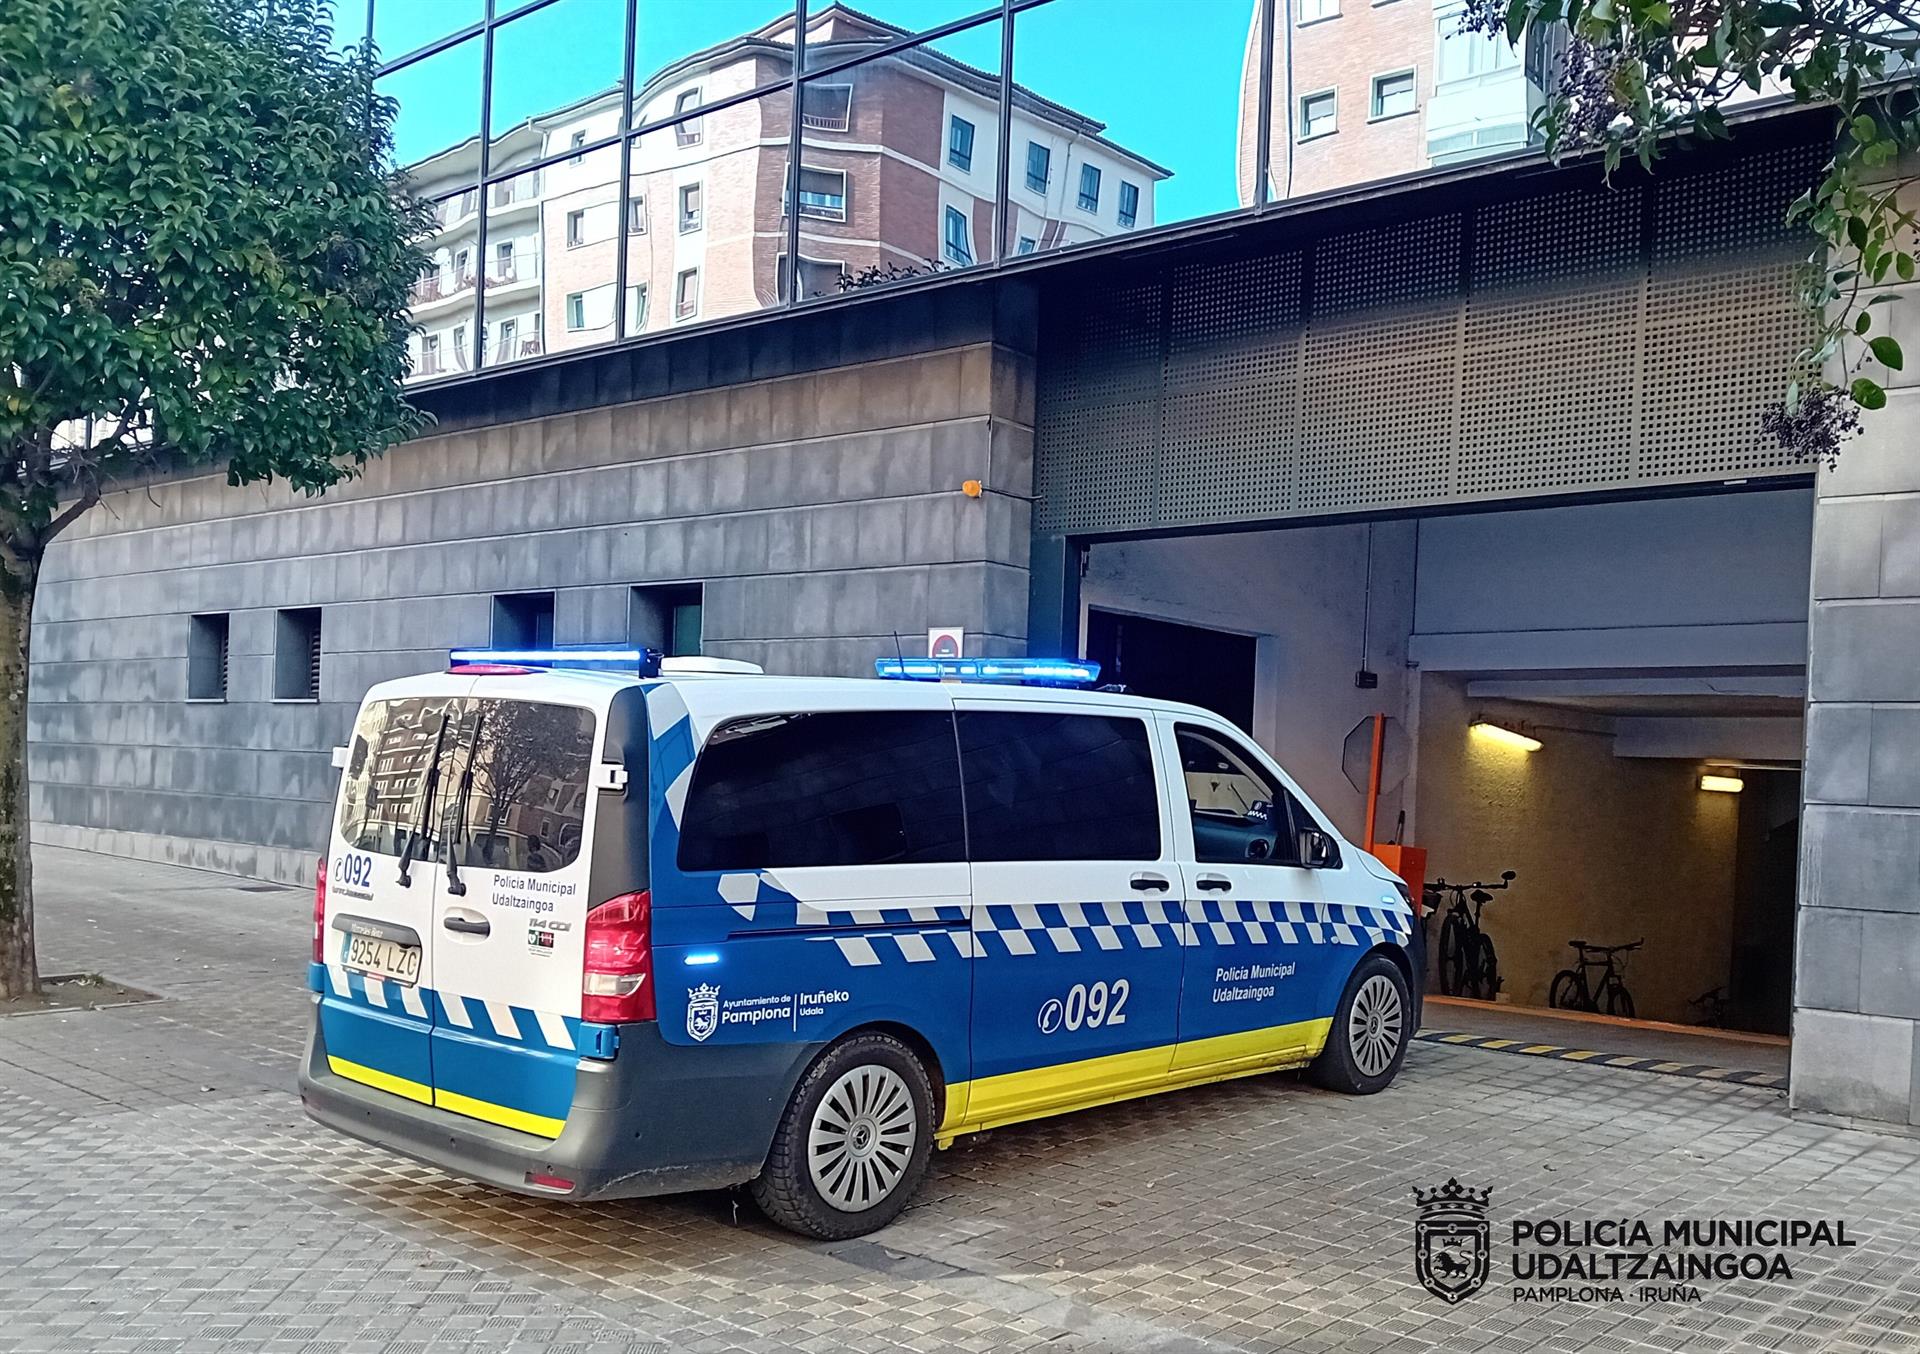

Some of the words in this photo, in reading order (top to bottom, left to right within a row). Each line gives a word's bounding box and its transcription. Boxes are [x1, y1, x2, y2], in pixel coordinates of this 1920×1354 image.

[344, 853, 372, 887] 092
[527, 877, 576, 896] Municipal
[492, 892, 554, 914] Udaltzaingoa
[351, 938, 382, 968] 9254
[386, 946, 417, 976] LZC
[1215, 965, 1249, 982] Policía
[1250, 961, 1296, 979] Municipal
[723, 995, 780, 1010] Ayuntamiento
[780, 994, 791, 1003] de
[799, 990, 850, 1005] Iruñeko
[1212, 985, 1275, 1003] Udaltzaingoa
[799, 1007, 824, 1016] Udala
[1064, 978, 1129, 1032] 092
[721, 1007, 791, 1026] Pamplona
